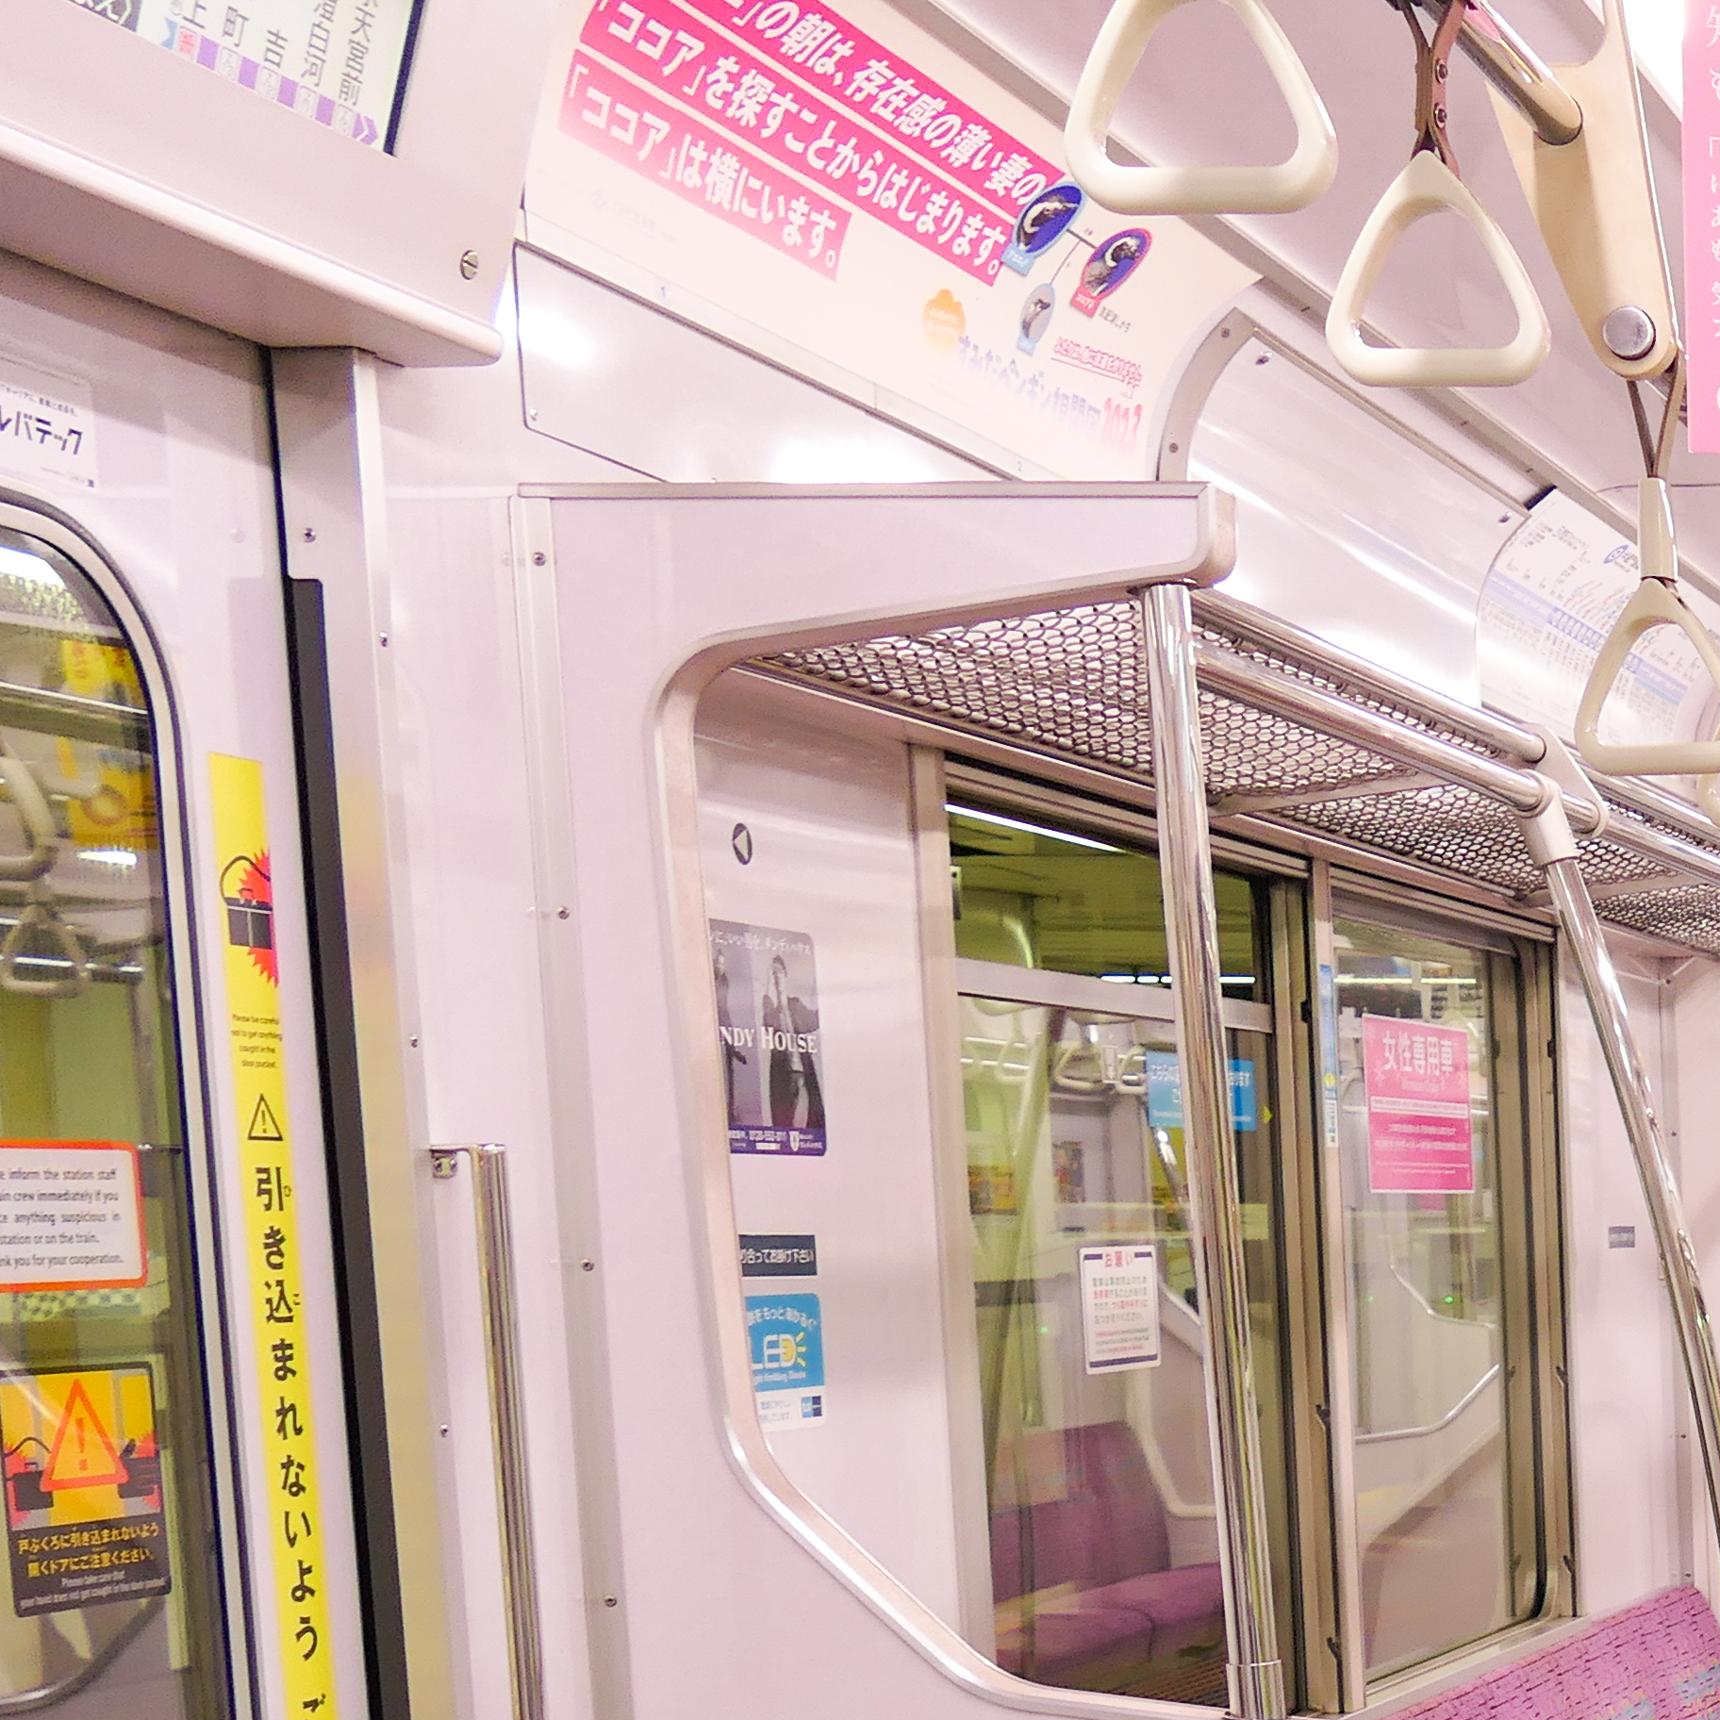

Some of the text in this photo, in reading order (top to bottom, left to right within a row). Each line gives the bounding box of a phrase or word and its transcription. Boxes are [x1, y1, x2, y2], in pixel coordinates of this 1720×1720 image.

[568, 63, 837, 269] 「ココア」は横にいます。
[597, 0, 1000, 276] ココア」を探すことからはじまります。
[731, 0, 1047, 207] 」の朝は、存在感の薄い妻の
[719, 1025, 818, 1053] NDY HOUSE
[1382, 1030, 1456, 1077] 女性専用車
[255, 1166, 319, 1663] 引き込まれないよう
